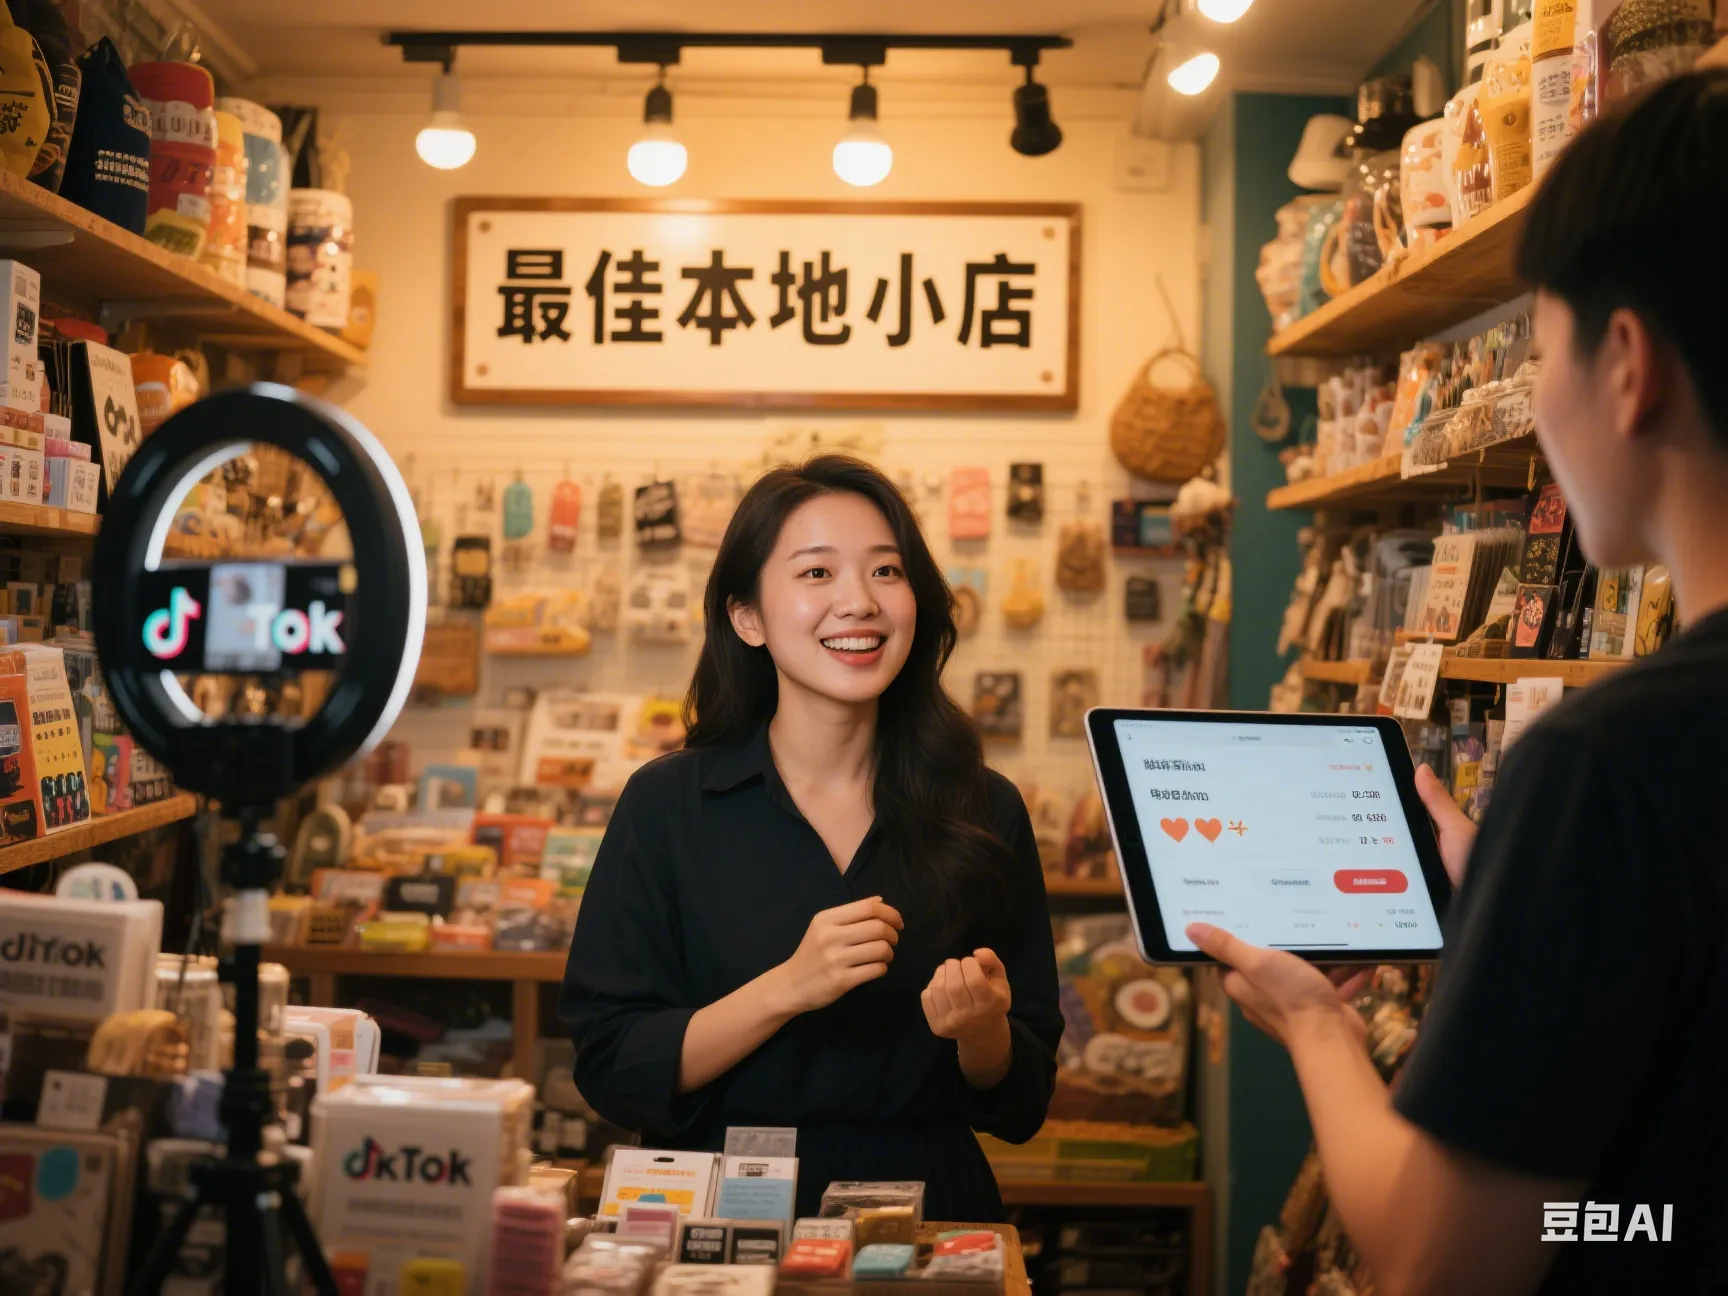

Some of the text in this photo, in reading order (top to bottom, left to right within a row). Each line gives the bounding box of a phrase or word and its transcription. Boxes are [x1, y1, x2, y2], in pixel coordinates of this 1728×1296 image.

[496, 249, 1036, 349] 最佳本地小店
